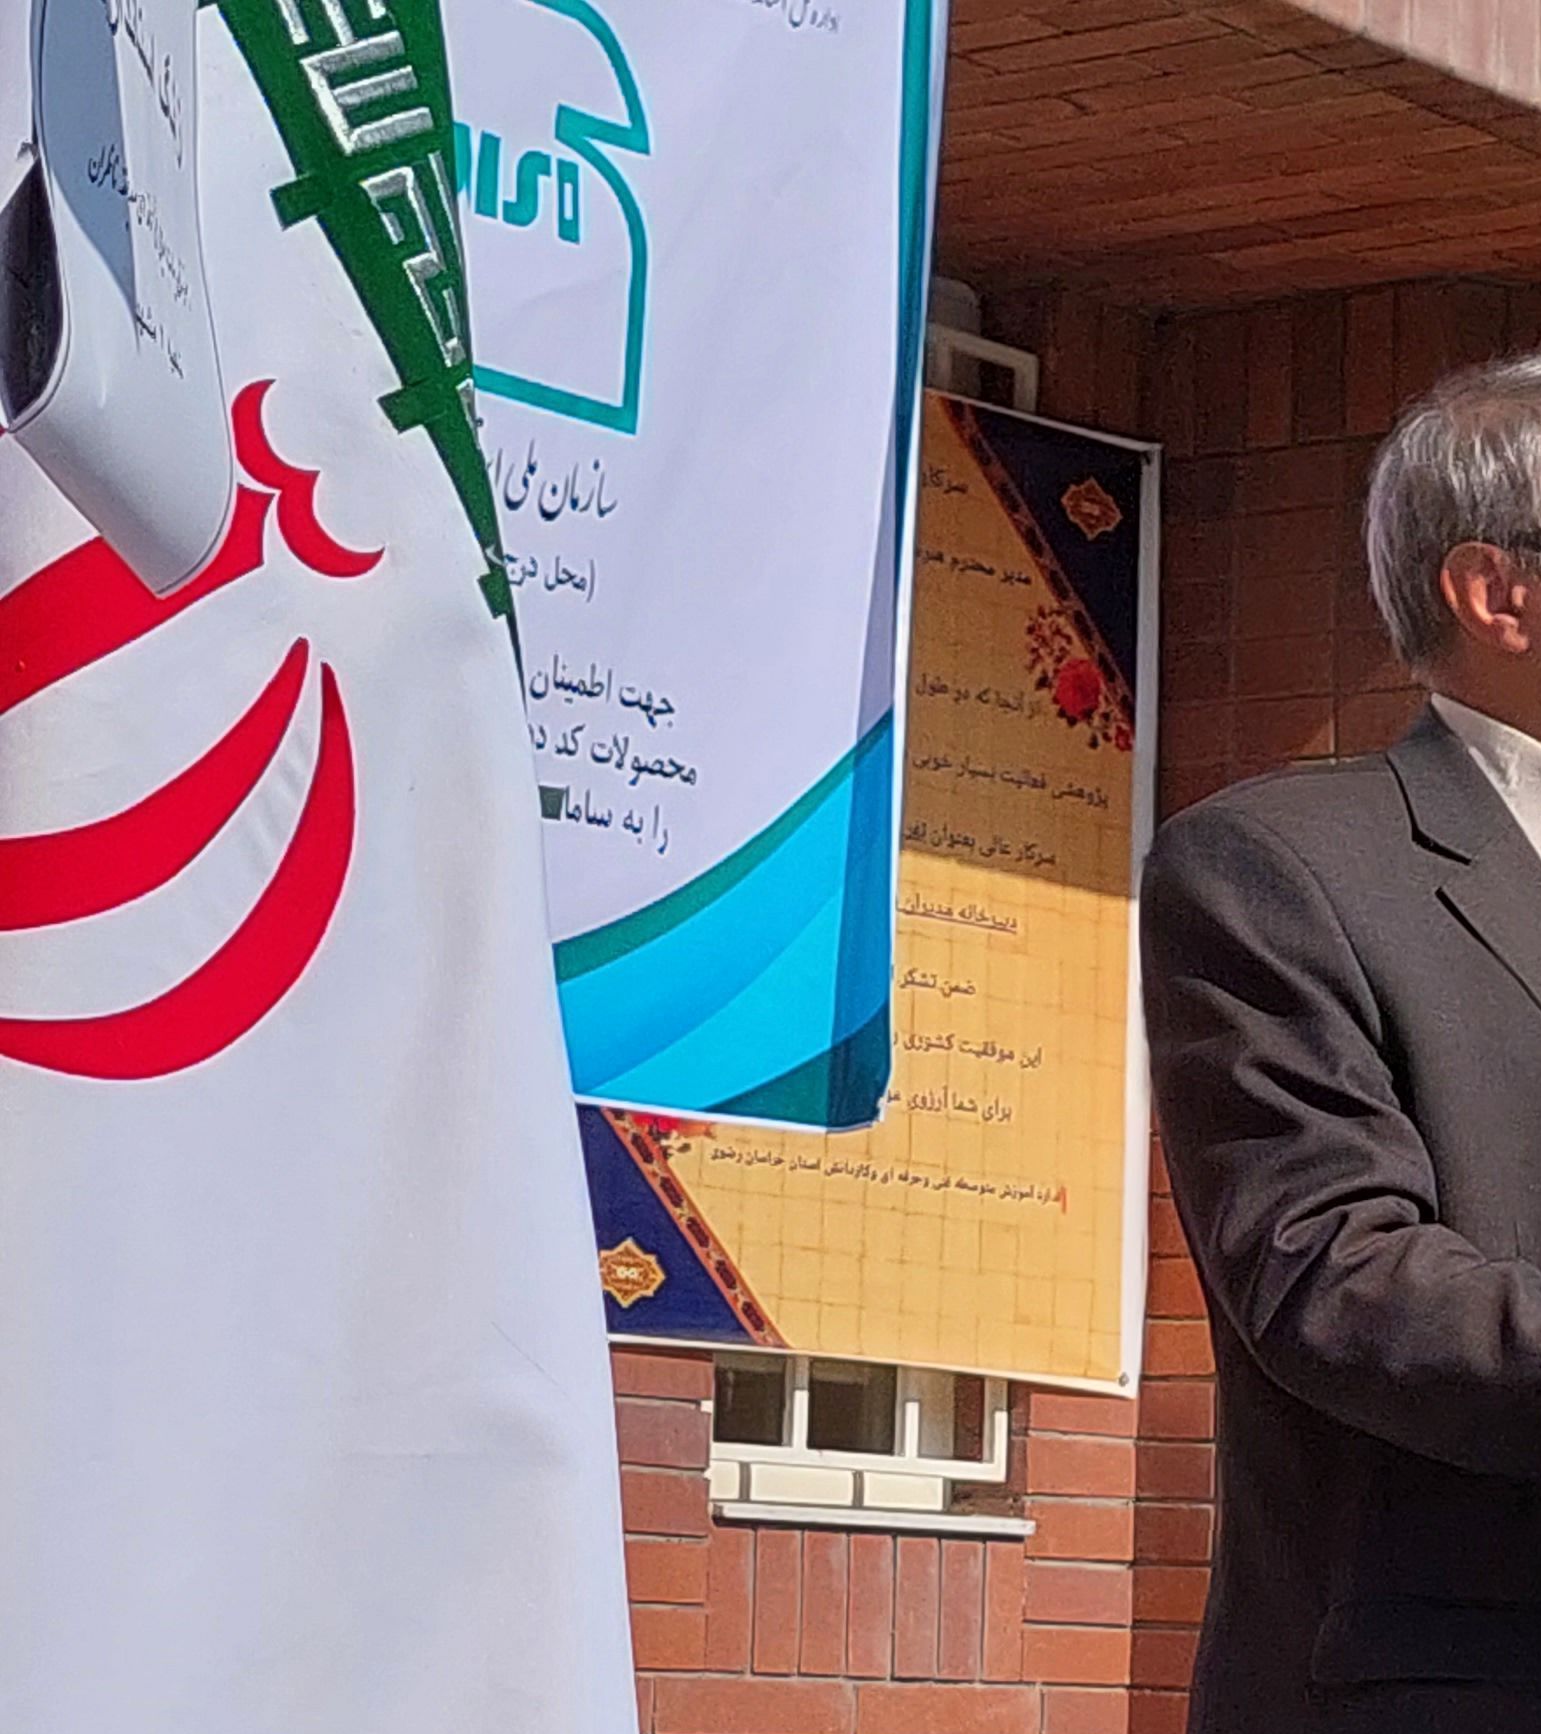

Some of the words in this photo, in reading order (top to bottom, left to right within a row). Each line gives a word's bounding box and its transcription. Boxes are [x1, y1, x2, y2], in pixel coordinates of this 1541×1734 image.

[503, 437, 537, 511] ملی
[537, 458, 618, 521] سازمان
[529, 653, 613, 705] اطمینان
[619, 683, 676, 728] جهت
[555, 723, 586, 756] کد
[591, 734, 698, 787] محصولات
[622, 807, 645, 846] به
[653, 804, 670, 855] را
[957, 1037, 1016, 1063] موفقیت
[950, 1094, 979, 1114] شما
[981, 1095, 1013, 1122] برای
